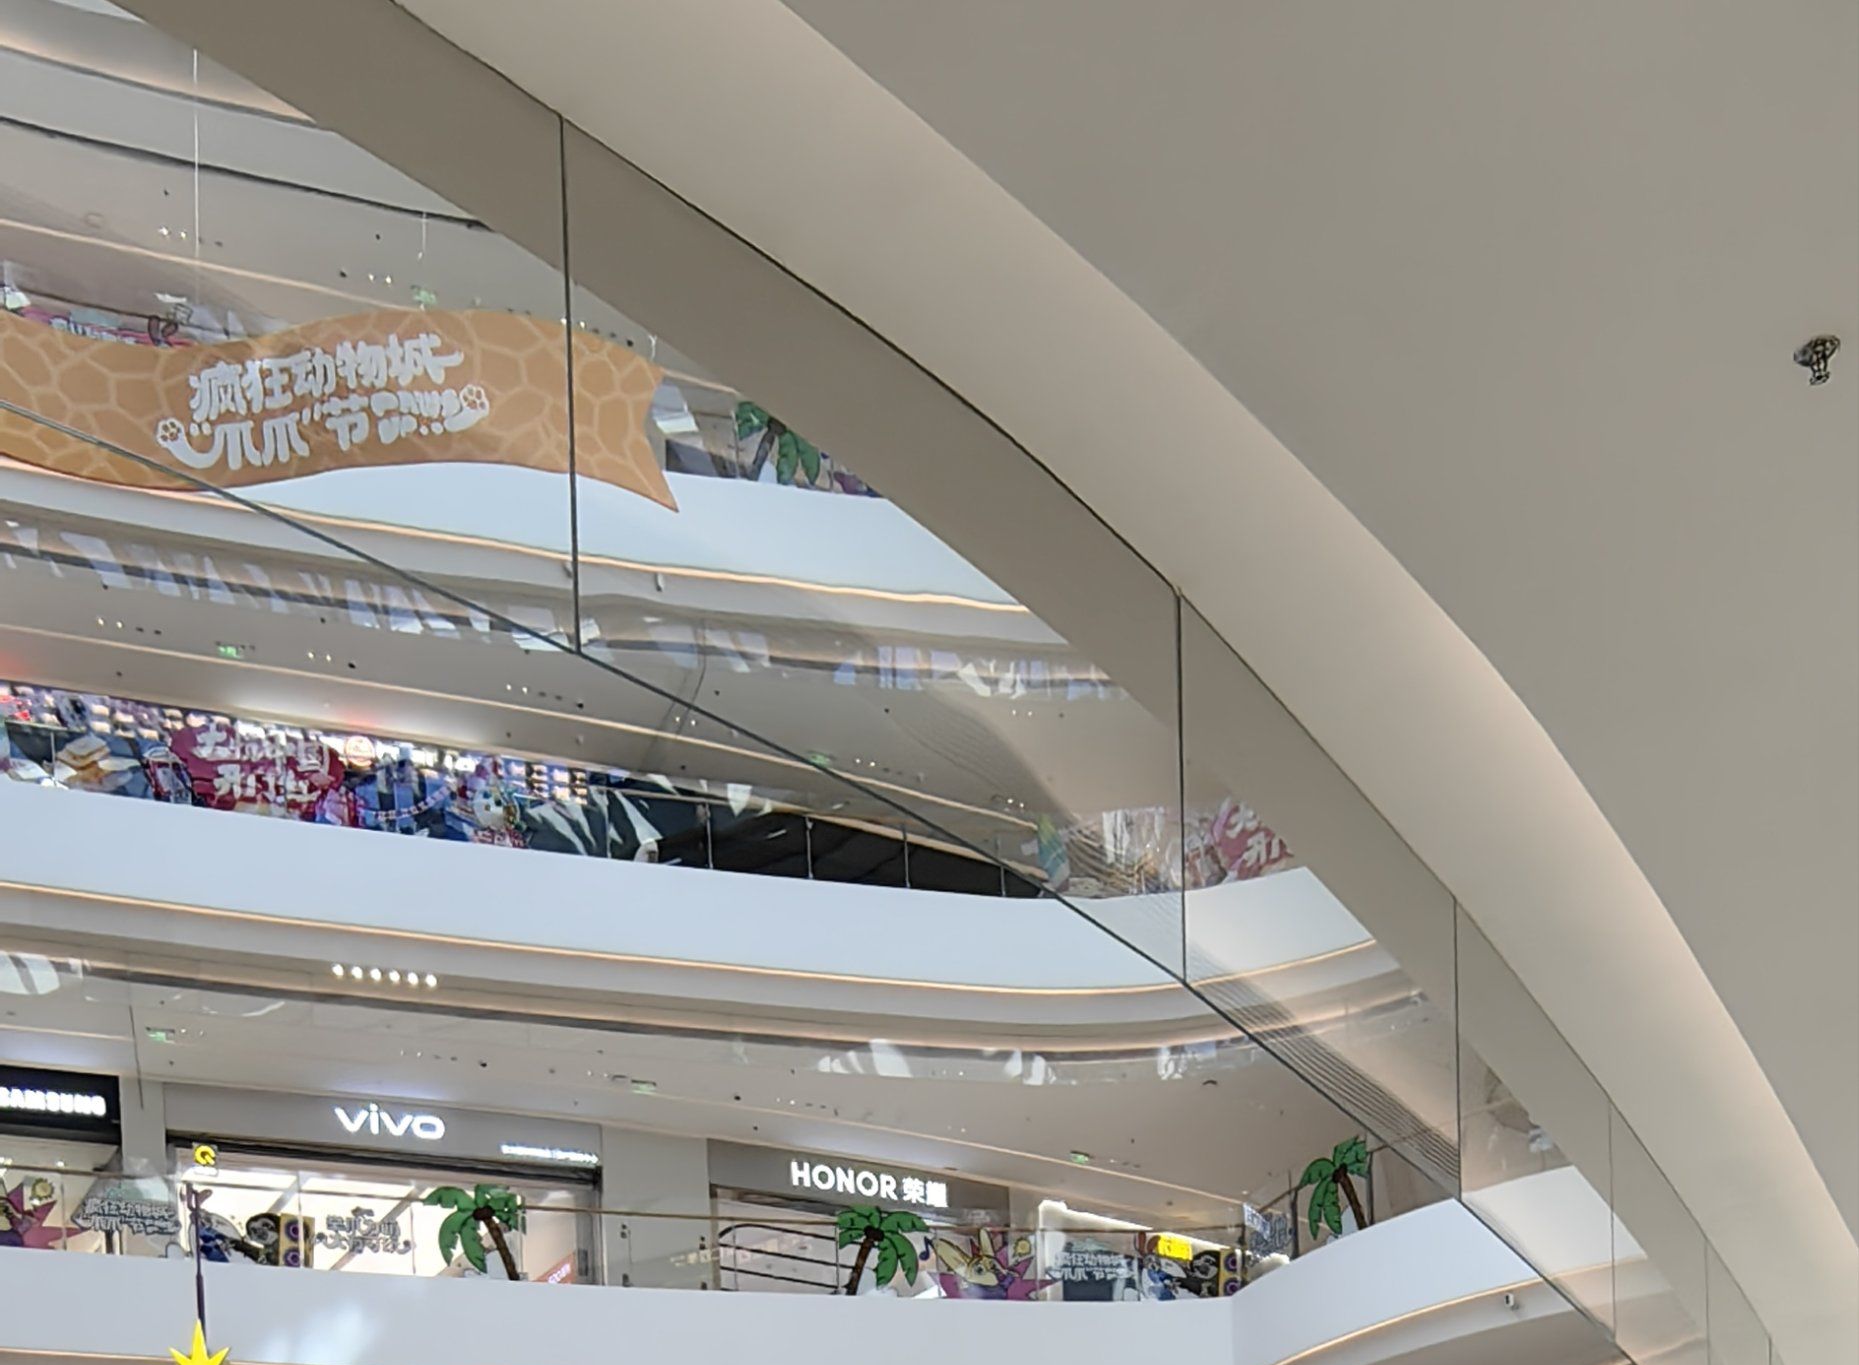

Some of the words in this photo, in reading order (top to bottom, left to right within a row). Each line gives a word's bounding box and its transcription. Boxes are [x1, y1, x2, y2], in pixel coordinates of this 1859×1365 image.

[188, 333, 465, 422] 疯狂动物城
[334, 1102, 446, 1140] vivo
[790, 1160, 898, 1201] HONOR
